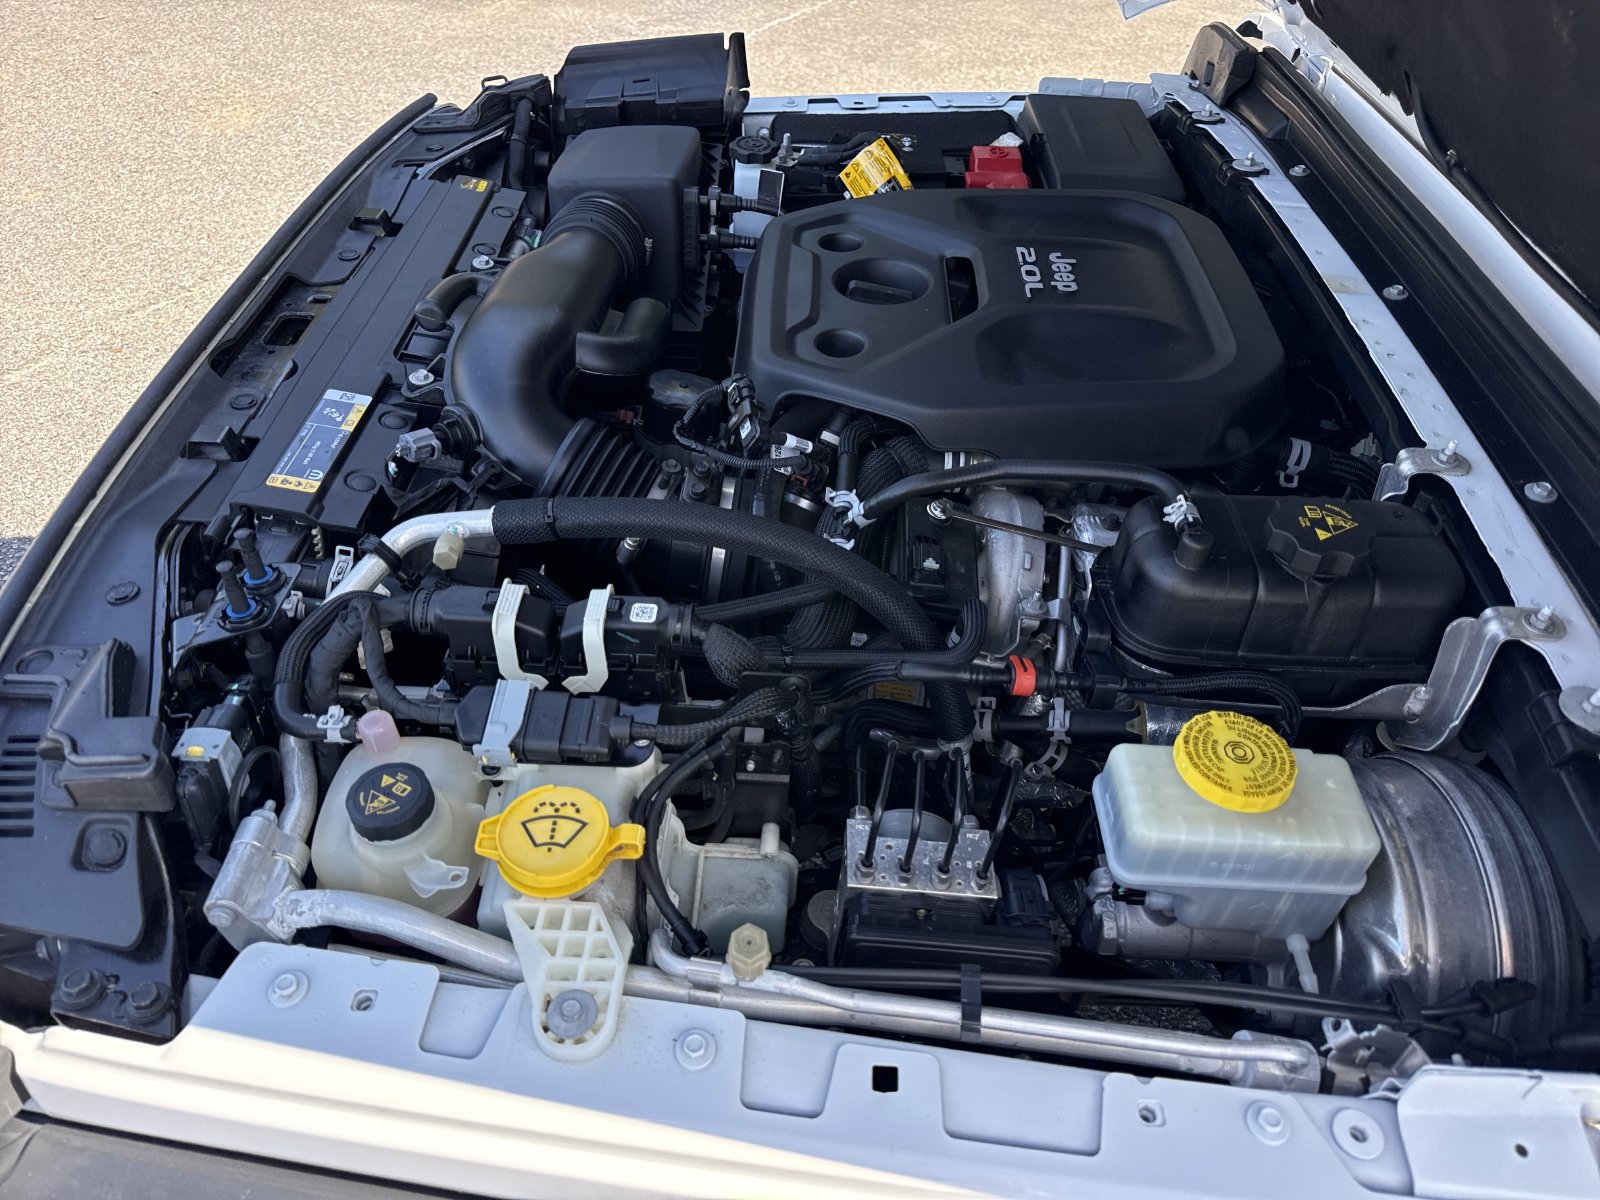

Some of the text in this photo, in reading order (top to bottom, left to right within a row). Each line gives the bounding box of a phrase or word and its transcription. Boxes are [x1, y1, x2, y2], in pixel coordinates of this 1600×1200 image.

[1016, 246, 1044, 298] 2.0L
[1048, 252, 1078, 292] Jeep
[1238, 726, 1263, 740] LIQUIDE
[1245, 722, 1254, 730] DE
[1185, 748, 1200, 771] SEALED
[1199, 768, 1232, 792] CONTAINER
[1200, 762, 1213, 772] USE
[1213, 771, 1230, 783] ONLY
